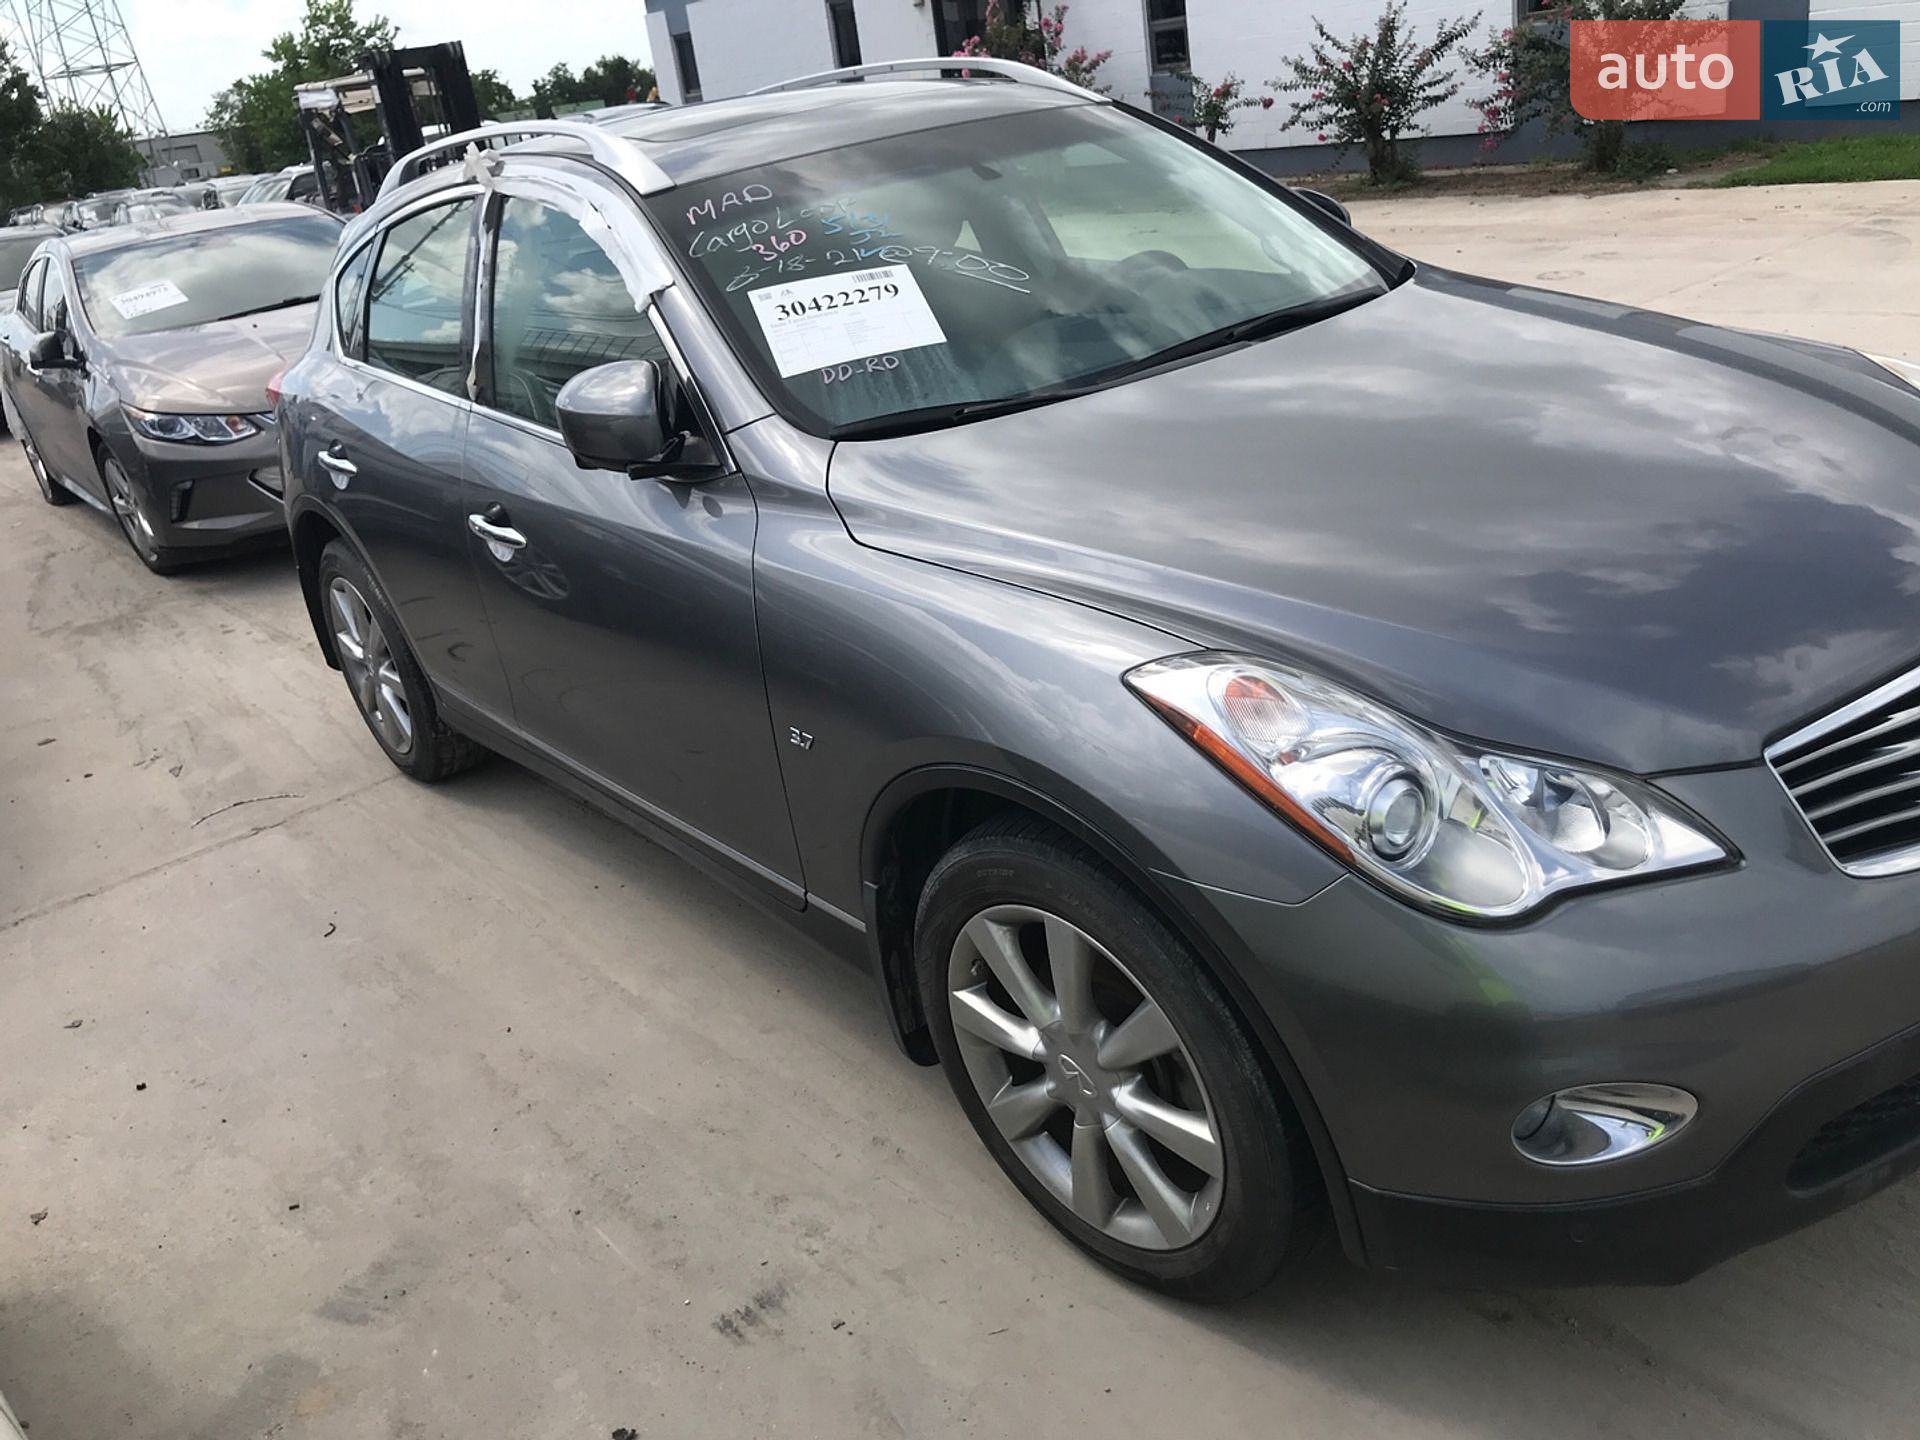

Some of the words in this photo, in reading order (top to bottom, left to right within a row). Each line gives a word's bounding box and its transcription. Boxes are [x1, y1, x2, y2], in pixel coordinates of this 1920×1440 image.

[686, 184, 773, 226] MAD
[688, 219, 769, 258] Cargo
[751, 229, 807, 262] 360
[774, 282, 900, 322] 30422279
[821, 355, 900, 385] DD-RD
